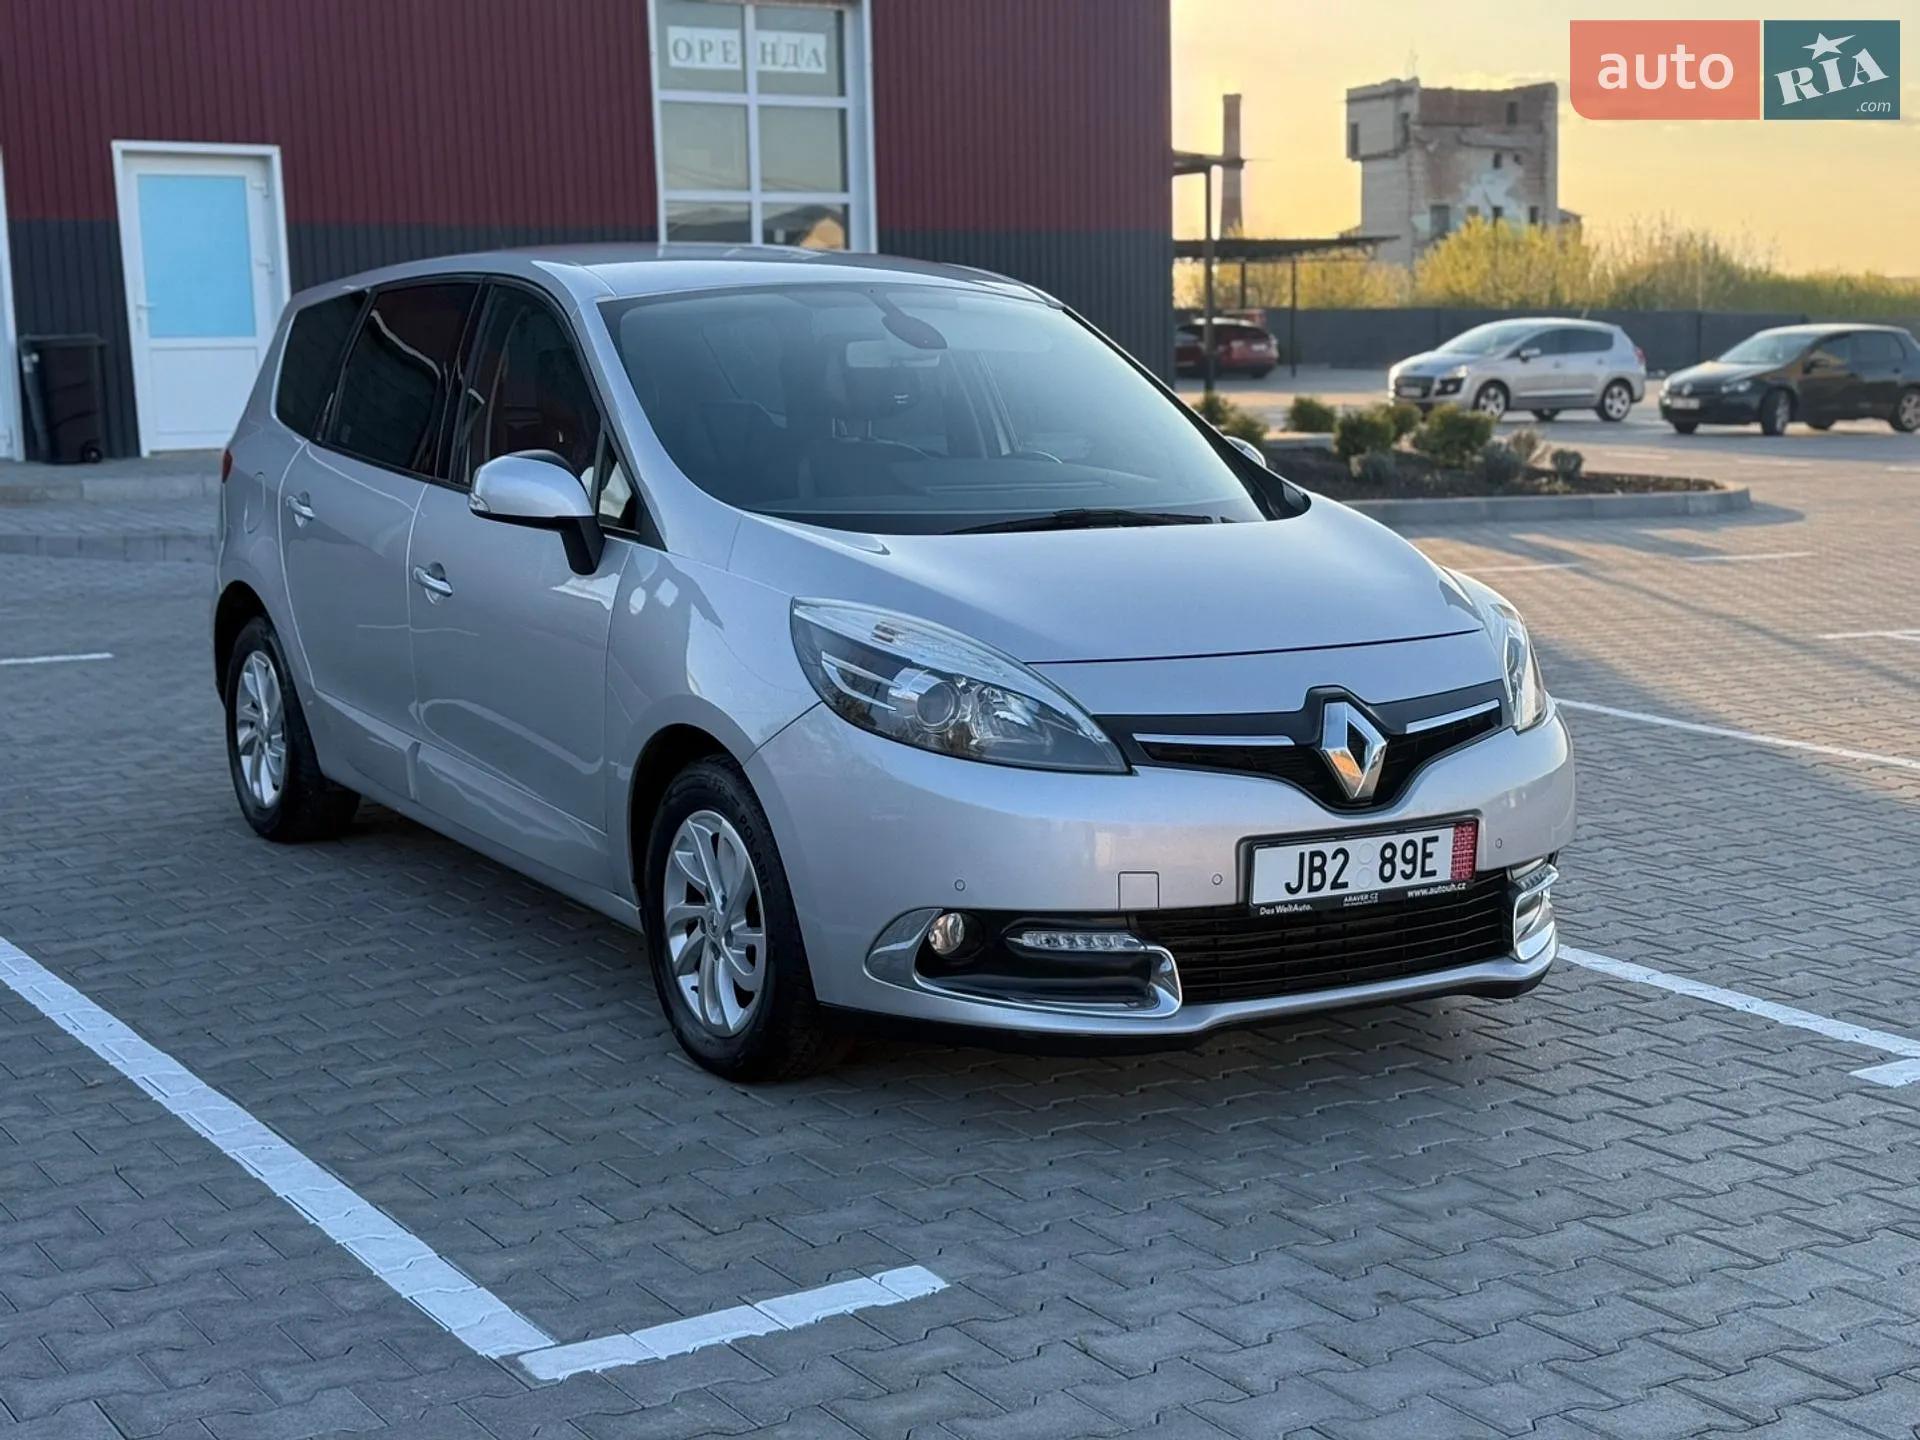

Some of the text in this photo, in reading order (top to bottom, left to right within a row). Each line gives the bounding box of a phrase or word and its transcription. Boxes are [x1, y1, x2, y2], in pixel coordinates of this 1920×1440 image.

[671, 37, 823, 69] ОРЕНДА
[1284, 847, 1350, 895] JB2
[1378, 835, 1440, 884] 89E
[1259, 907, 1274, 915] Das
